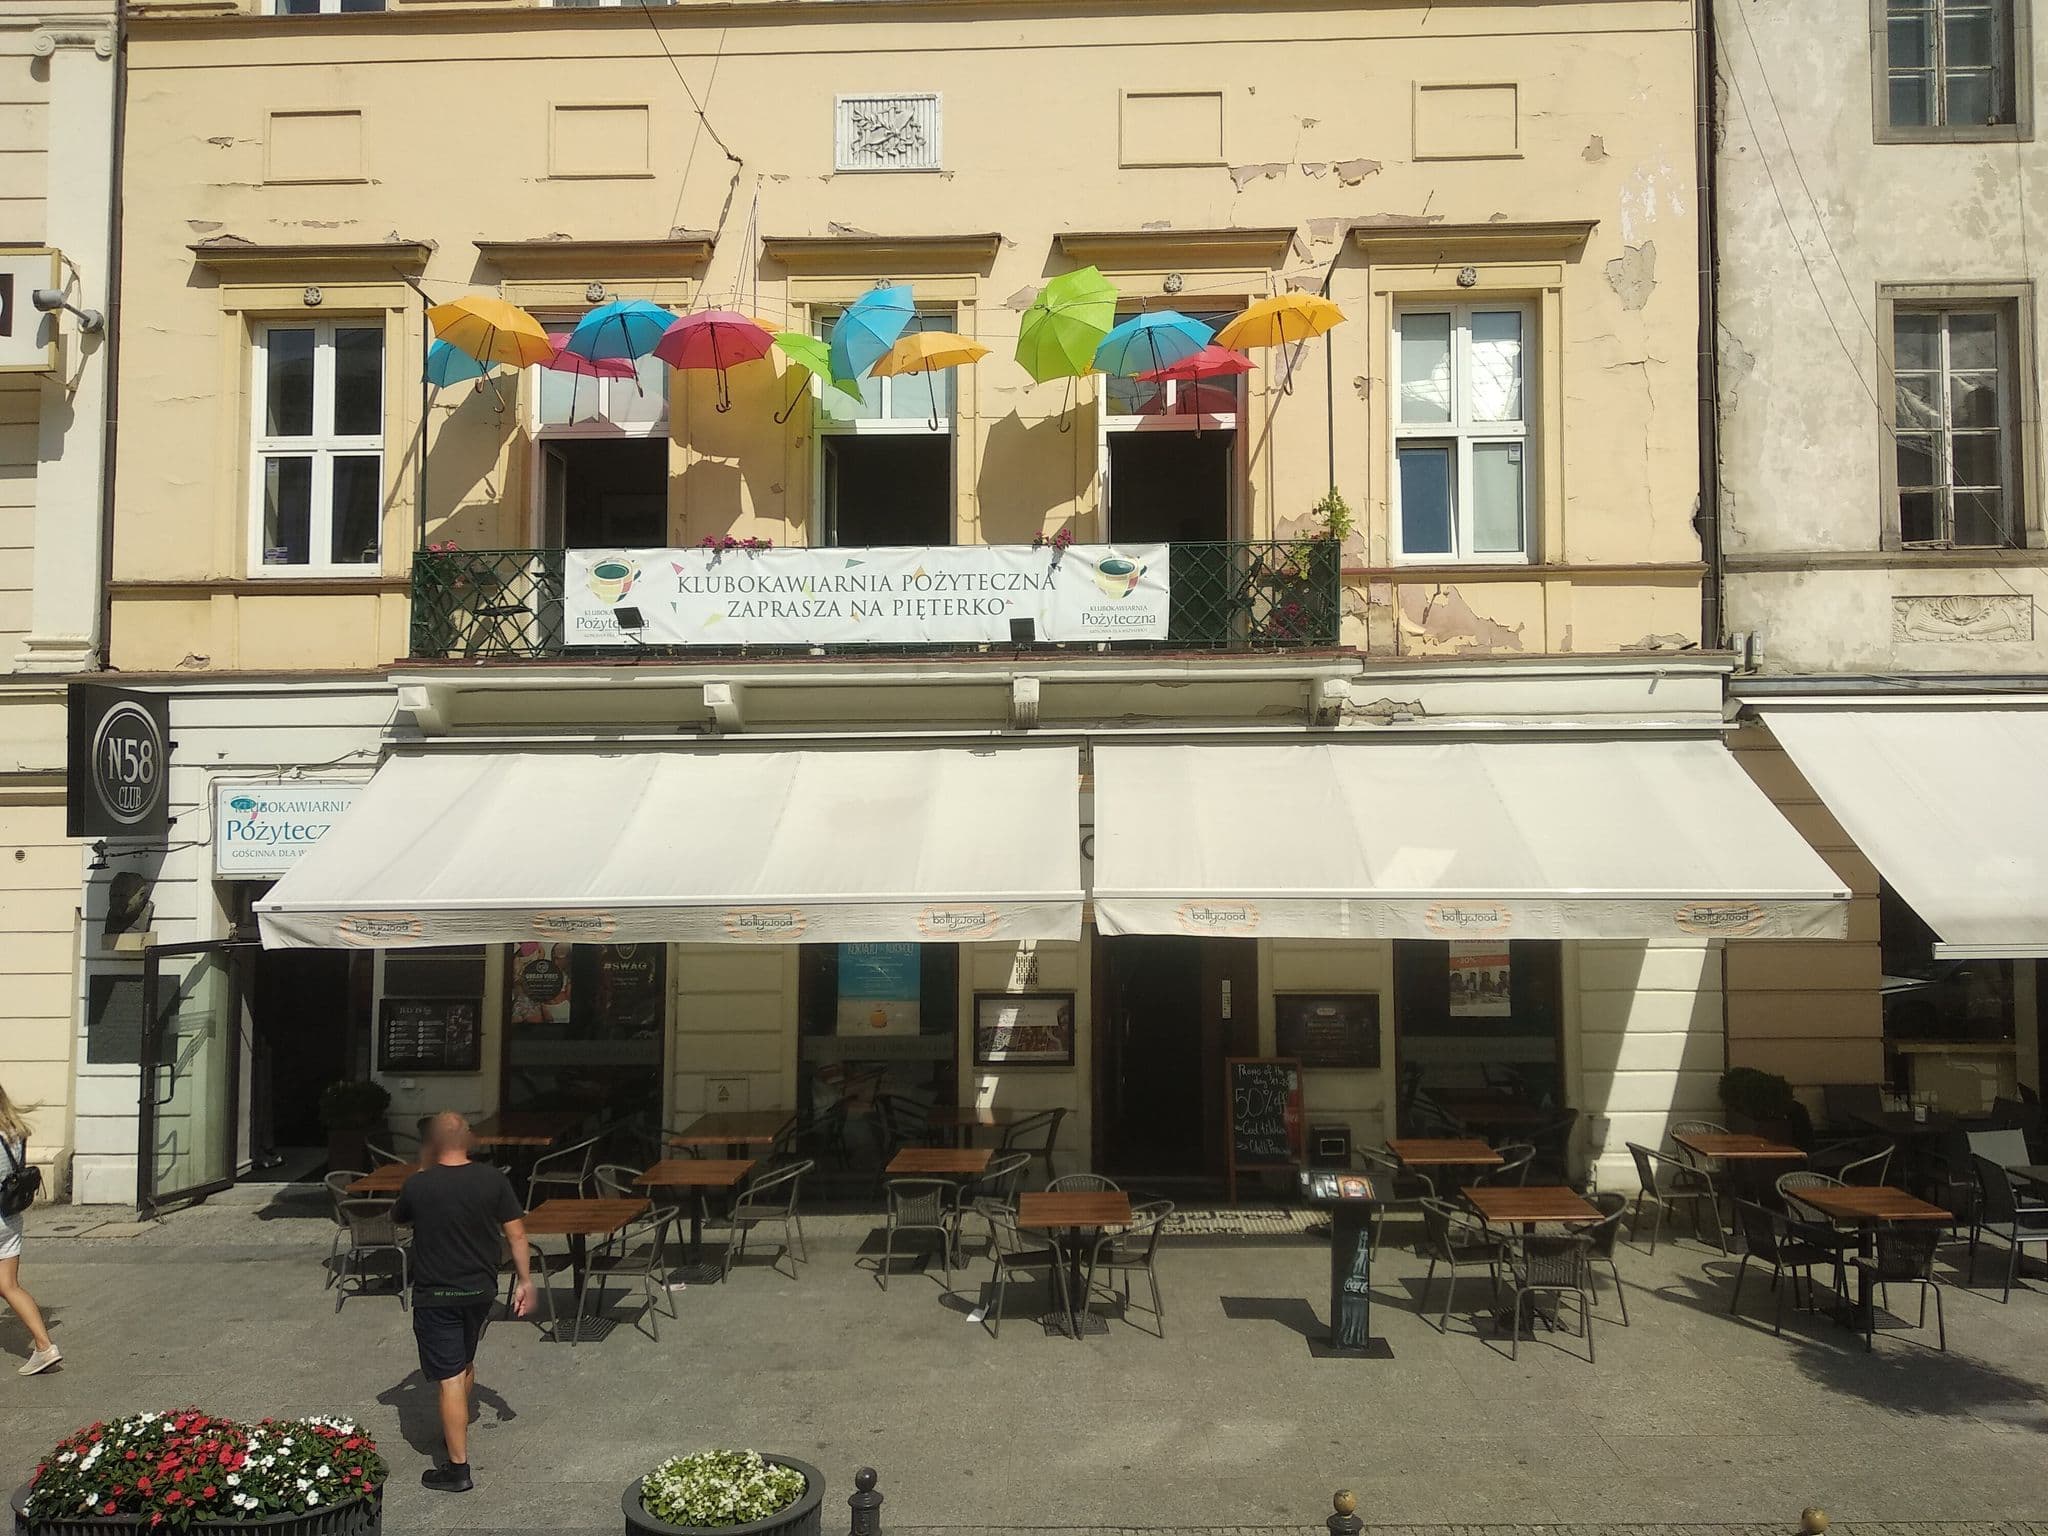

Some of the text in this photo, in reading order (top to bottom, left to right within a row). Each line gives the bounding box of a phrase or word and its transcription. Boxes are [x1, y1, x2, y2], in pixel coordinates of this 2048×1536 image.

[677, 570, 1057, 594] KLUBOKAWIARNIA POŻYTECZNA
[727, 598, 1005, 621] ZAPRASZA NA PIĘTERKO
[576, 616, 650, 632] Pożytea
[1081, 612, 1156, 628] Pożyteczna
[107, 737, 154, 784] N58
[118, 786, 142, 809] CLUB
[227, 819, 332, 845] Pożytecz
[232, 848, 277, 857] GOŚCINNA
[738, 912, 793, 931] bollywood
[932, 911, 986, 928] bollywood
[1190, 906, 1247, 924] bollywood
[1440, 908, 1498, 926] bollywood
[1693, 907, 1749, 924] bollywood
